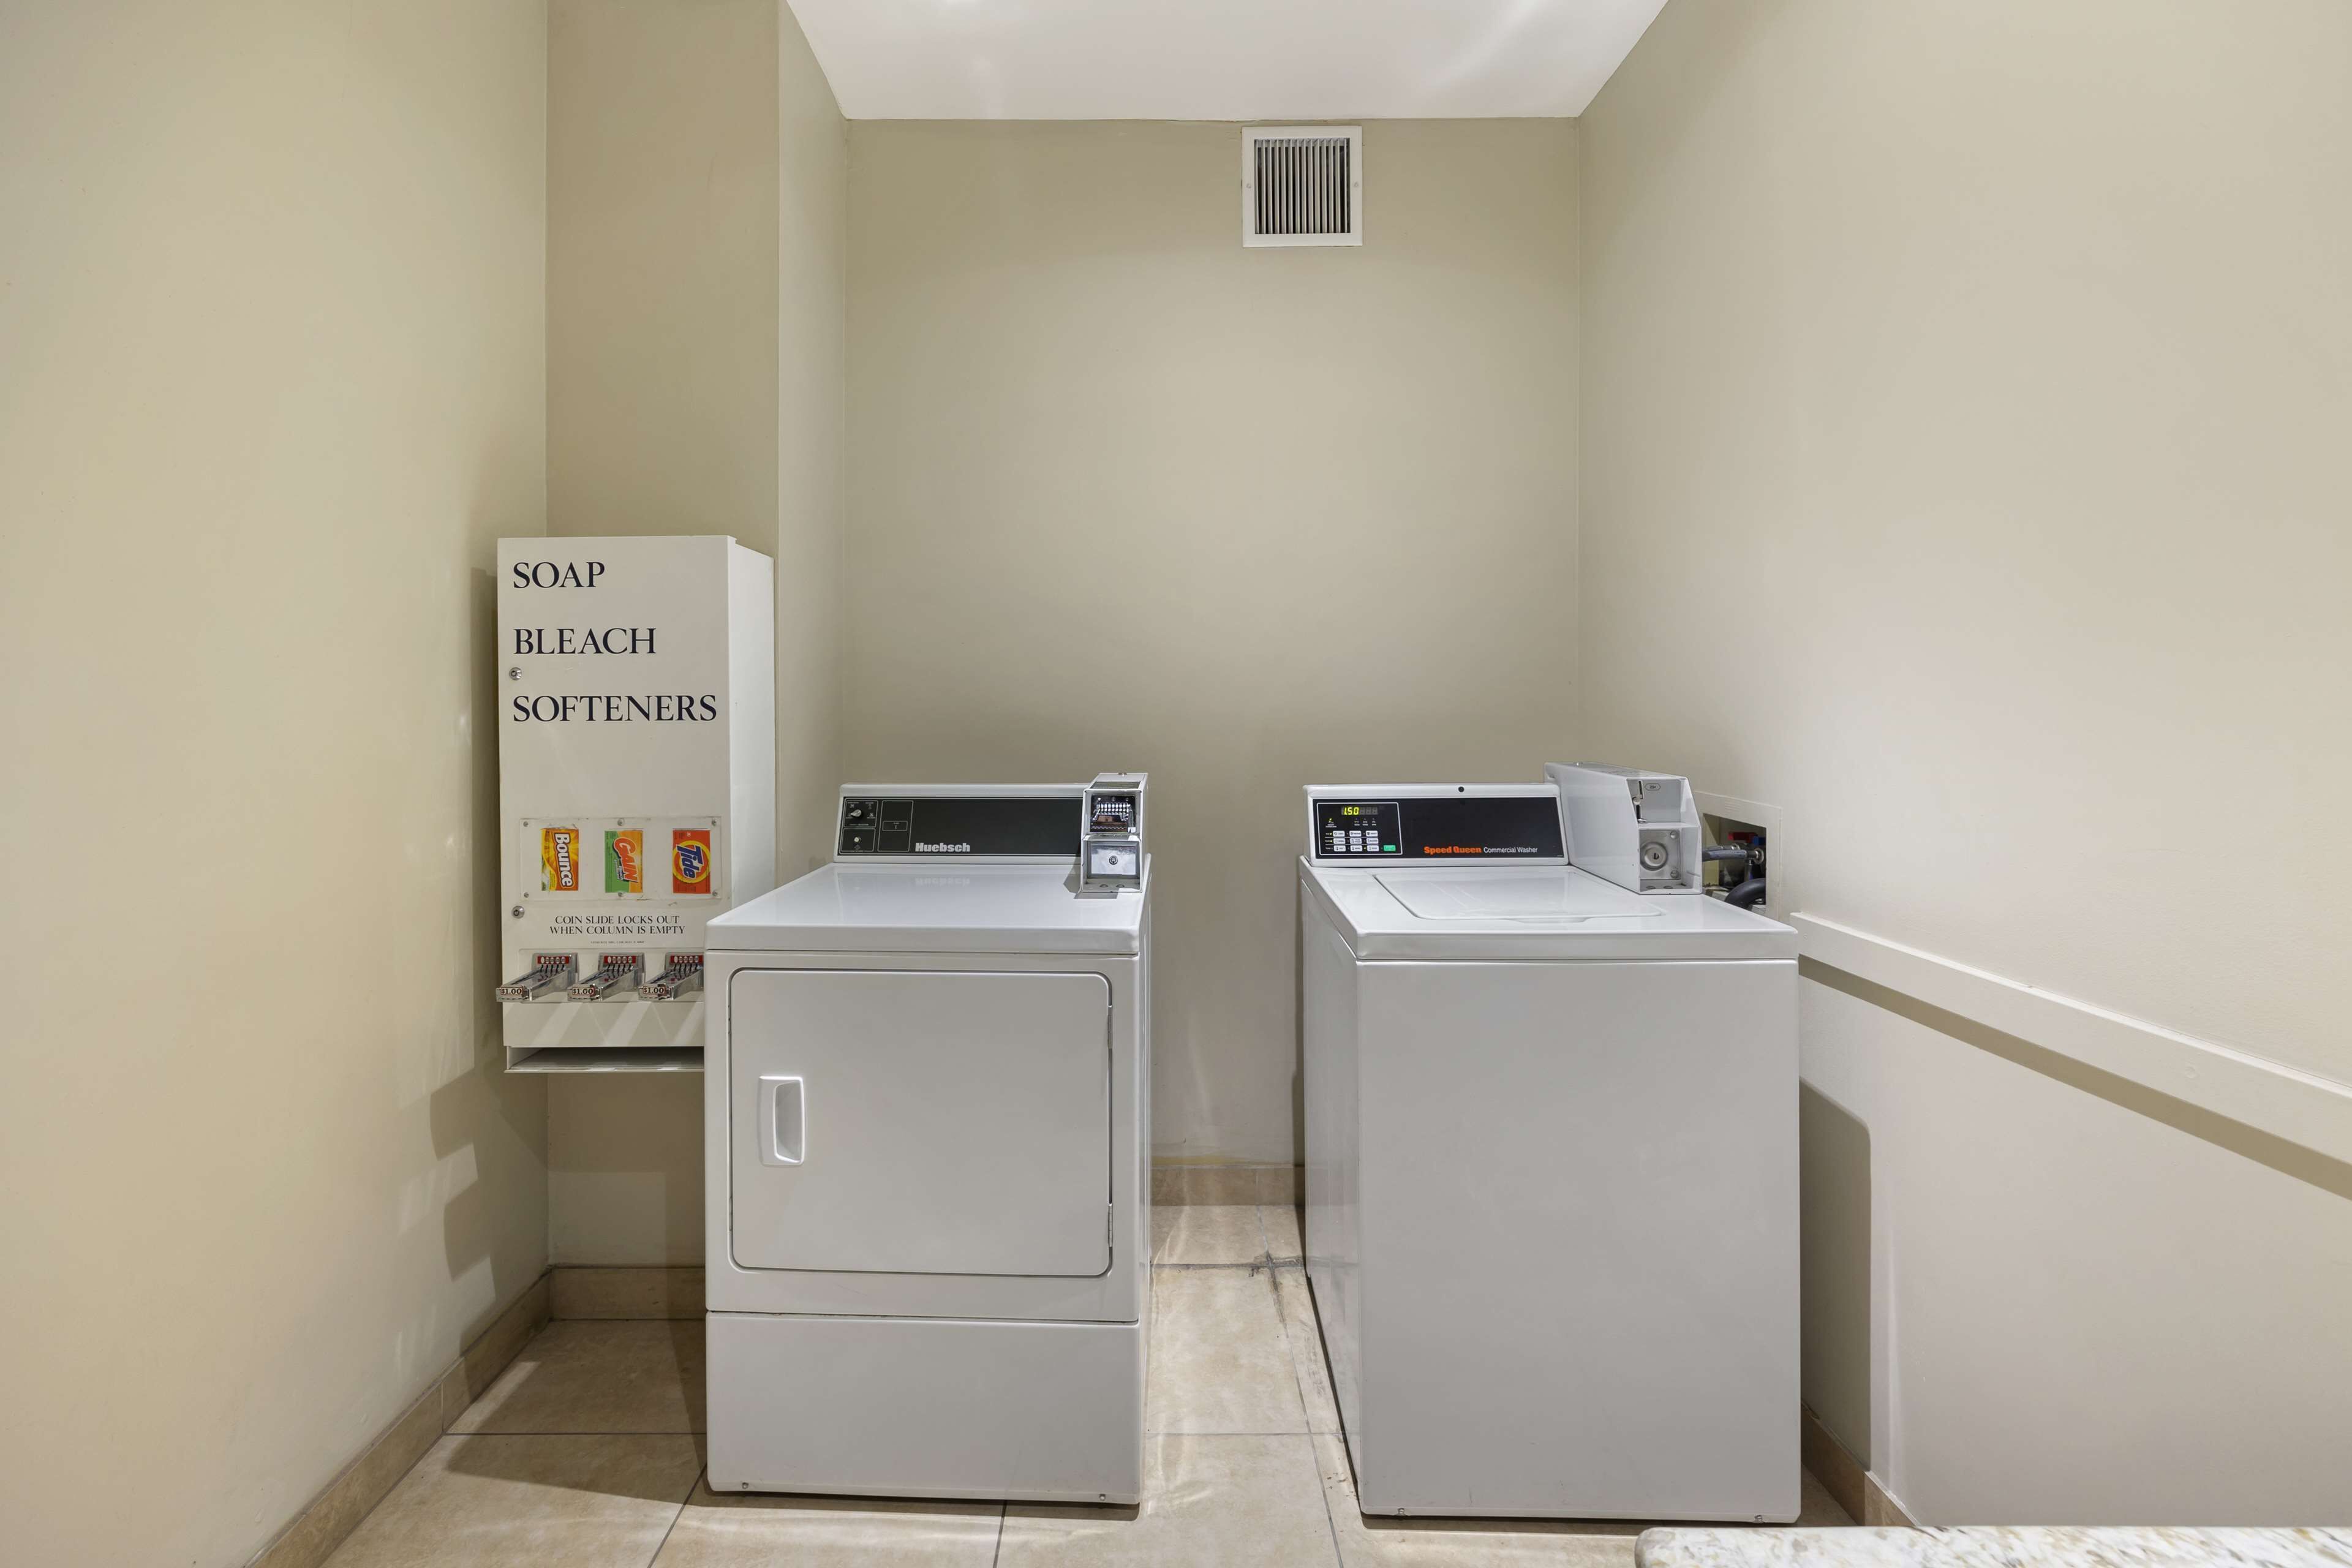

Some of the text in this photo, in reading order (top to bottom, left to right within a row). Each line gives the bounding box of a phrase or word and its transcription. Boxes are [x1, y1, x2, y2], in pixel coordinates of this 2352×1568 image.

[513, 562, 605, 589] SOAP
[513, 627, 657, 655] BLEACH
[513, 694, 717, 722] SOFTENERS
[554, 833, 573, 887] Bounce
[915, 842, 971, 852] Huebsch
[1423, 846, 1452, 855] Speed
[676, 845, 704, 878] Tide
[555, 916, 679, 924] COIN SLIDE LOCKS OUT
[650, 925, 685, 934] EMPTY
